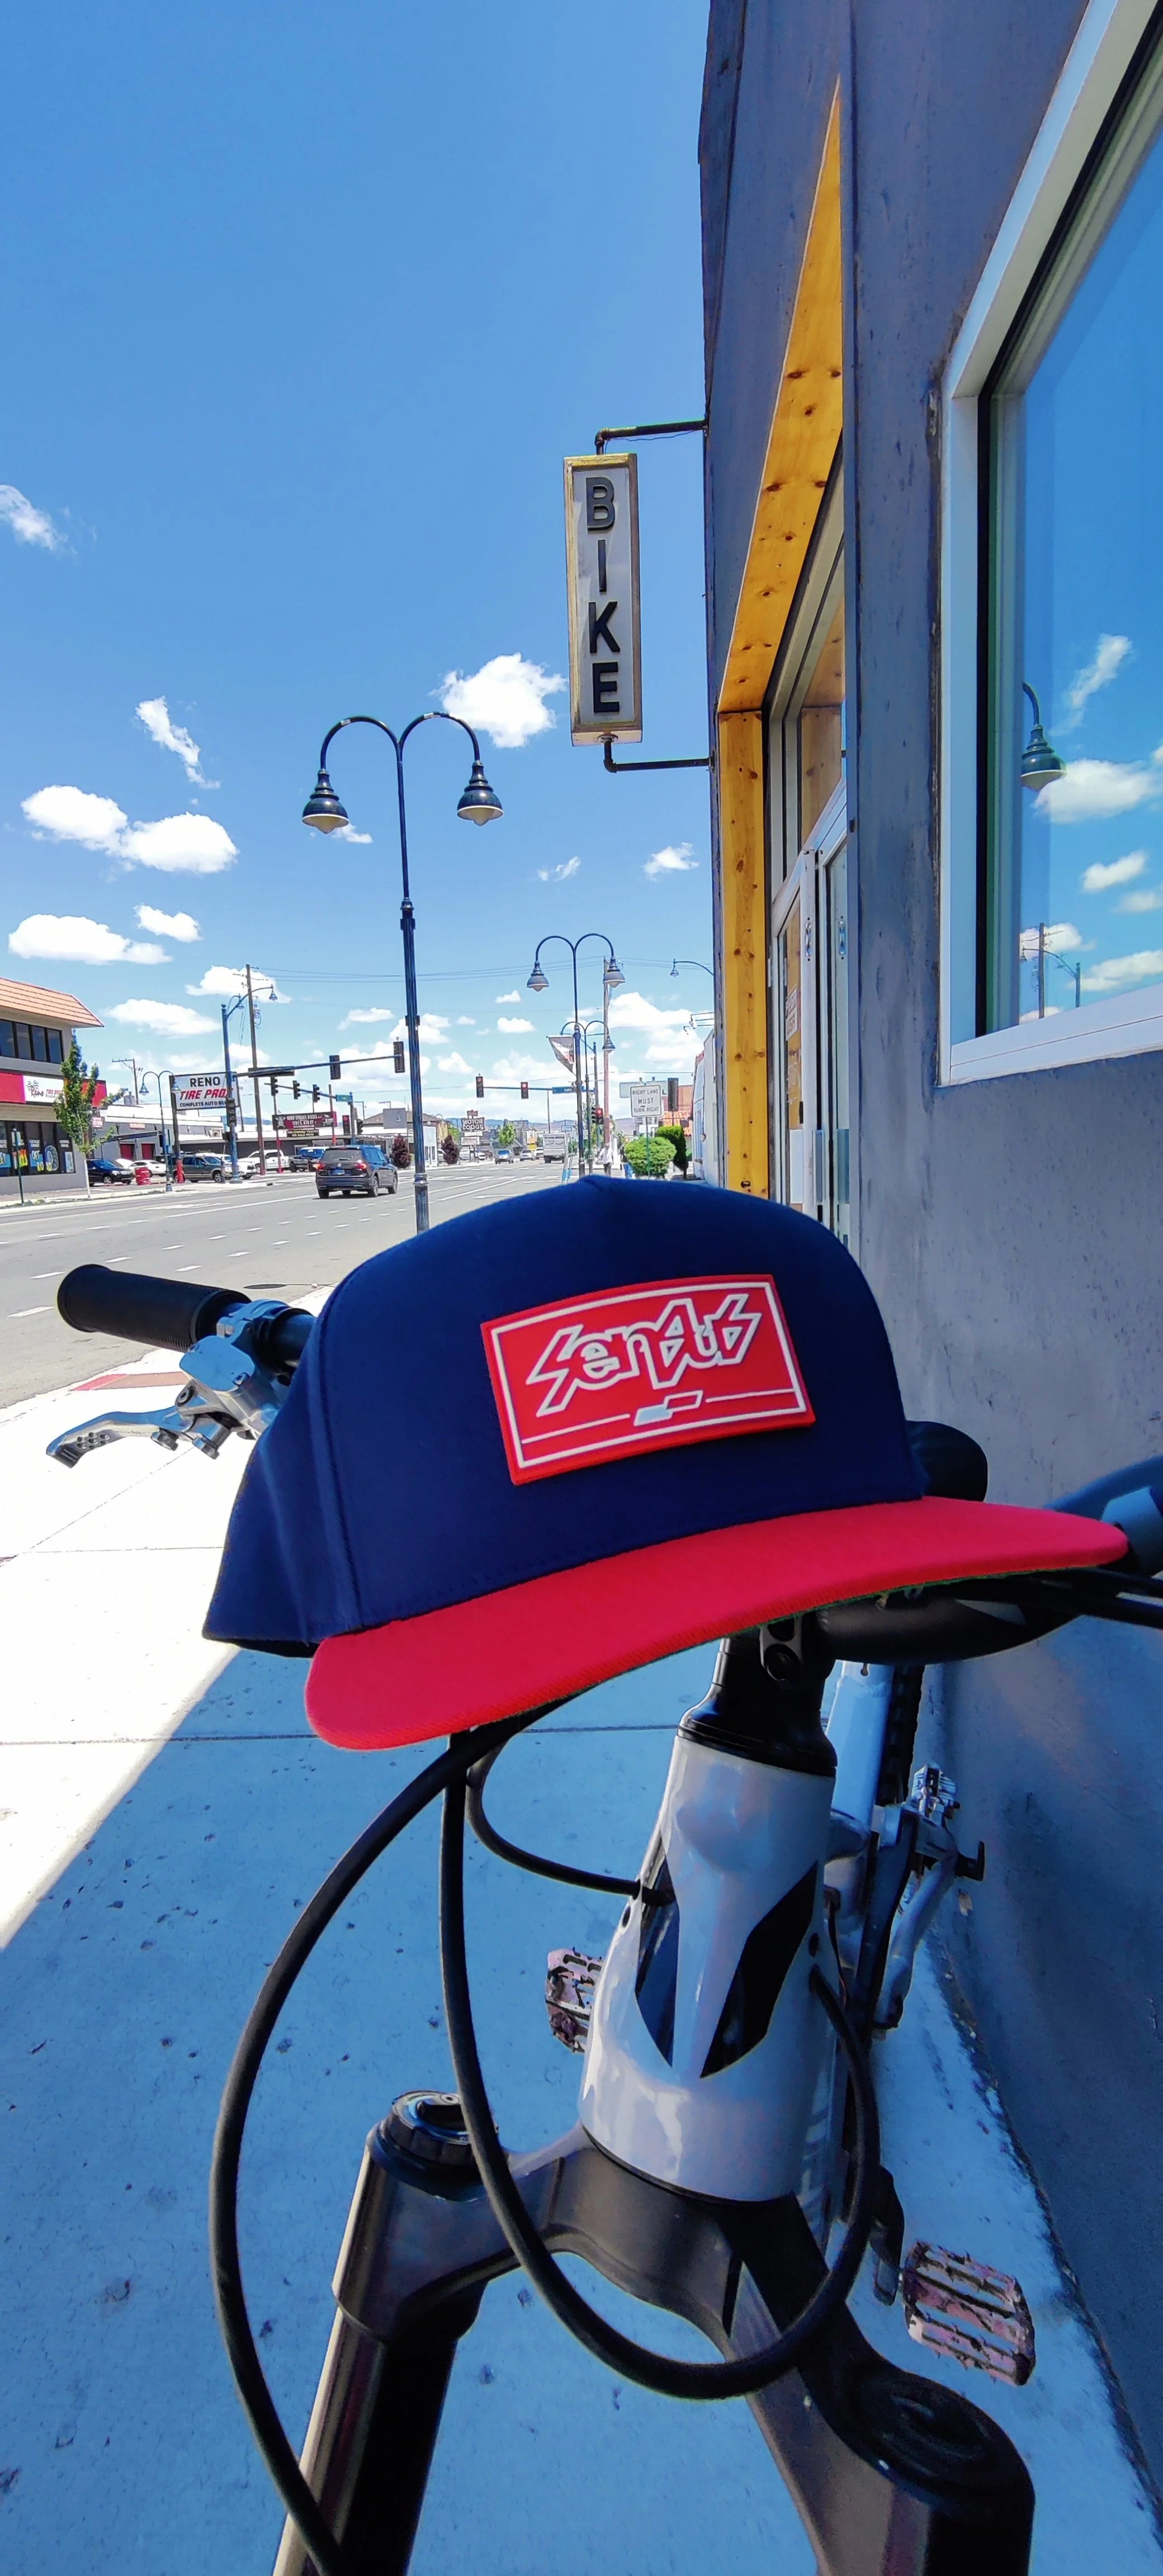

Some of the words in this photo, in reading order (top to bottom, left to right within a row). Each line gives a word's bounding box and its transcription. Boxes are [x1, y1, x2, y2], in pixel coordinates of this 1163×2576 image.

[585, 477, 621, 714] BIKE
[190, 1077, 220, 1087] RENO
[179, 1090, 202, 1100] TIRE
[204, 1088, 227, 1099] PRO
